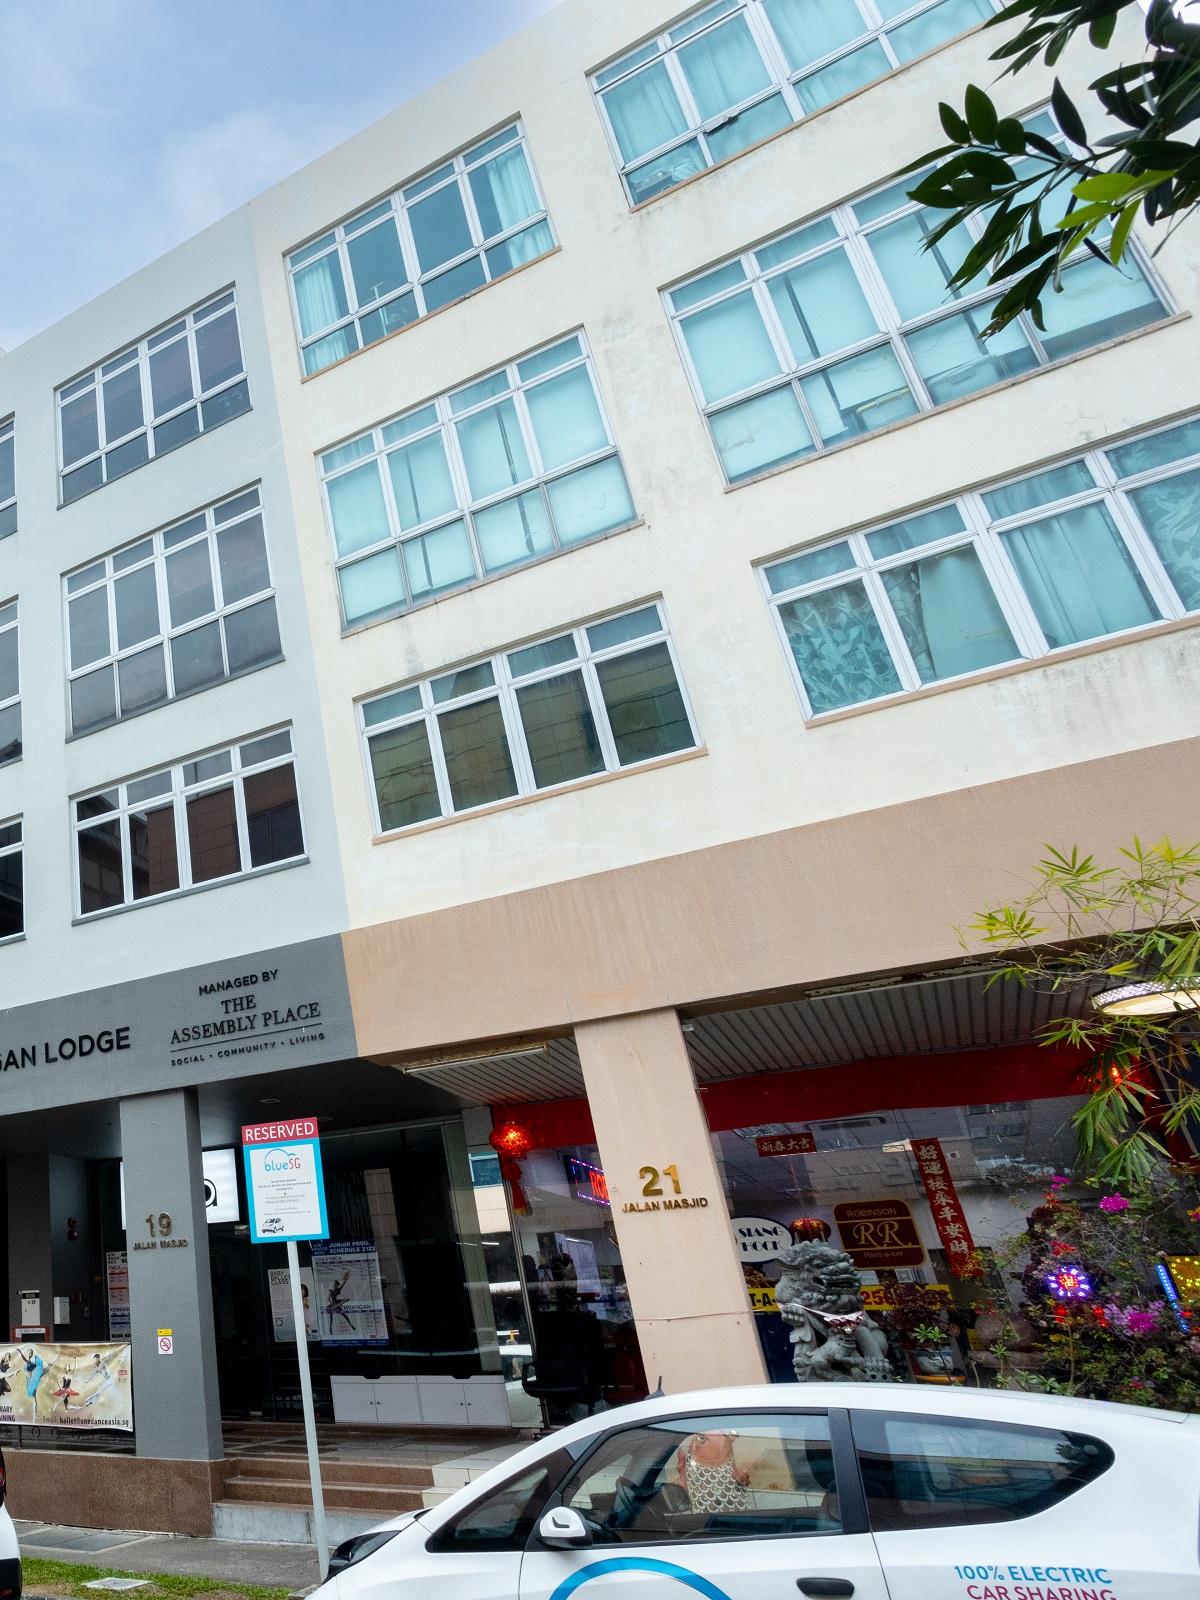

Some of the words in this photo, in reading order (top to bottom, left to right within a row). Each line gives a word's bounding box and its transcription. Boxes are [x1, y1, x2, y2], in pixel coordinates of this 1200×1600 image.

[198, 974, 258, 996] MANAGED
[261, 969, 279, 982] BY
[220, 994, 257, 1014] THE
[170, 1014, 258, 1045] ASSEMBLY
[262, 1002, 322, 1027] PLACE
[44, 1026, 131, 1064] LODGE
[170, 1054, 205, 1067] SOCIAL
[217, 1041, 276, 1059] COMMUNITY
[289, 1032, 326, 1046] LIVING
[245, 1122, 315, 1142] RESERVED
[264, 1157, 302, 1172] blueSG
[638, 1163, 682, 1197] 21
[622, 1200, 661, 1214] JALAN
[663, 1197, 709, 1211] MASJID
[845, 1206, 898, 1218] ROBINSON
[145, 1212, 173, 1238] 19
[738, 1225, 784, 1238] SIANG
[133, 1240, 157, 1251] JALAN
[159, 1239, 189, 1249] MASJID
[740, 1240, 786, 1251] HOCK
[59, 1416, 129, 1428] ballet@onedanceasia.sg
[954, 1565, 1005, 1580] 100%
[1007, 1566, 1113, 1585] ELECTRIC
[966, 1584, 1009, 1600] CAR
[1013, 1585, 1116, 1600] SHARING
